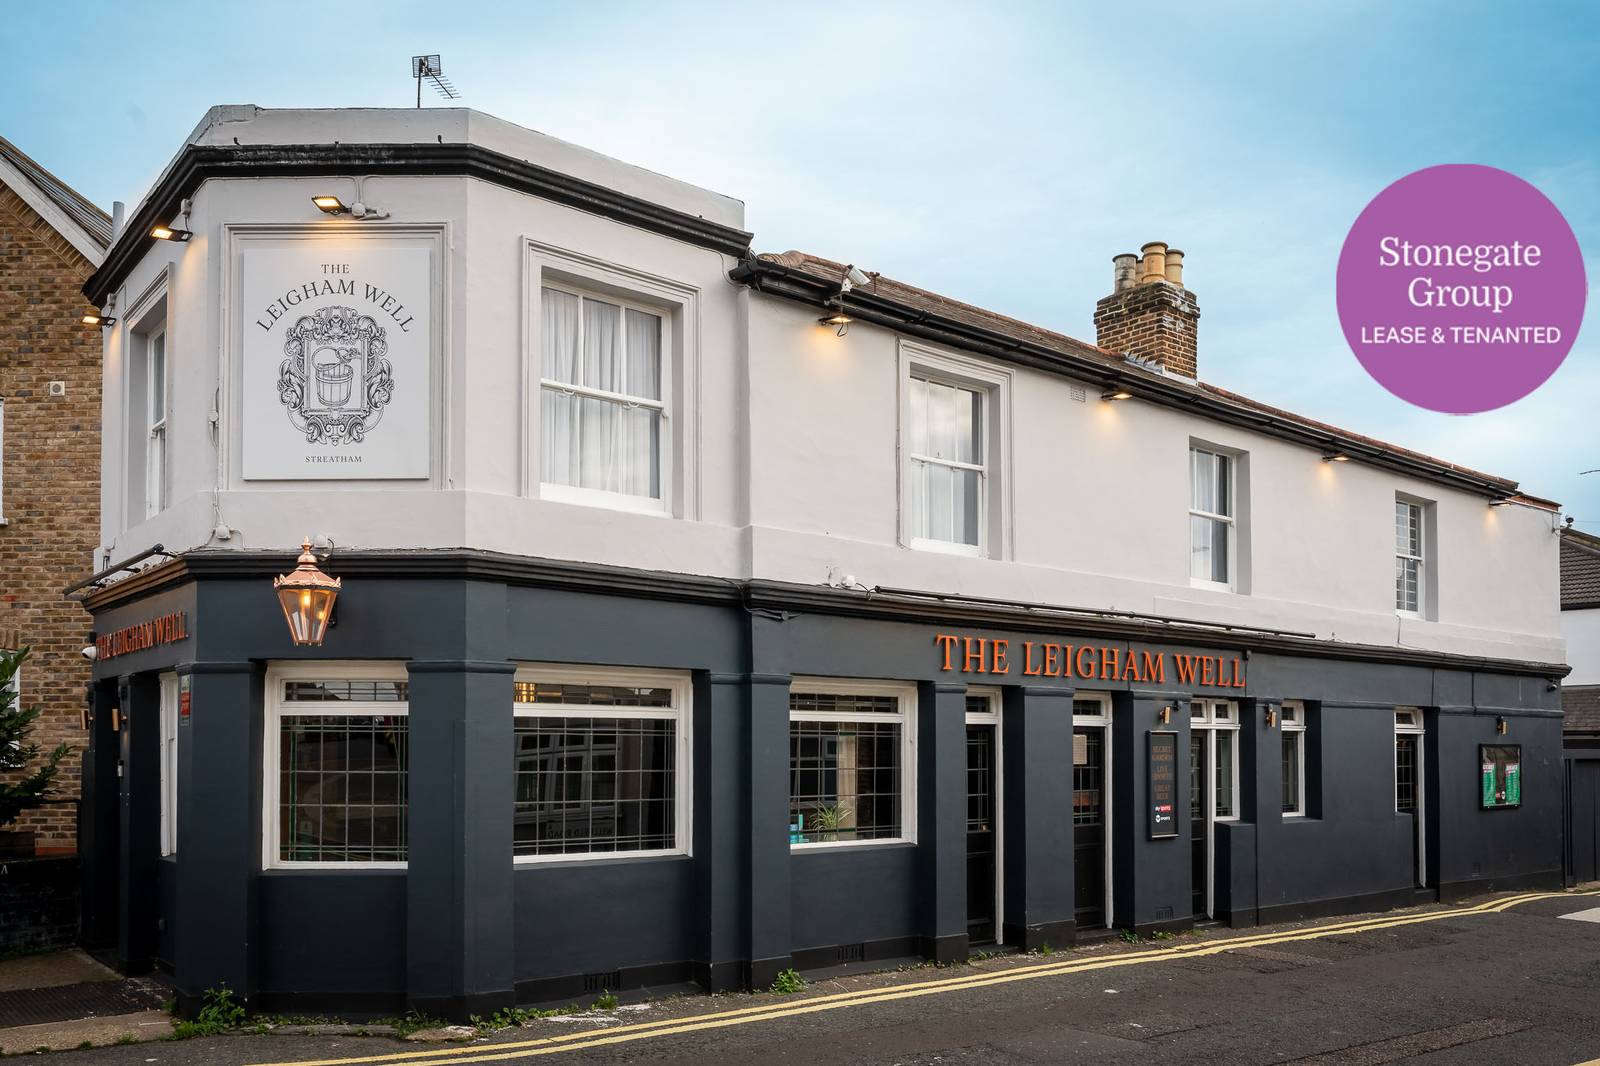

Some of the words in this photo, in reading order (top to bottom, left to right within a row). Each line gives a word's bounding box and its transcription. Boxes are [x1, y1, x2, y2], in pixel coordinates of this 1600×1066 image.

[321, 264, 350, 274] THE
[256, 279, 355, 332] LEIGHAM
[363, 283, 414, 333] WELL
[305, 455, 362, 463] STREATHAM
[96, 633, 112, 660] THE
[112, 621, 154, 656] LEIGHAM
[153, 610, 186, 643] WELL
[936, 633, 1010, 675] THE
[1023, 641, 1166, 683] LEIGHAM
[1174, 654, 1247, 687] WELL
